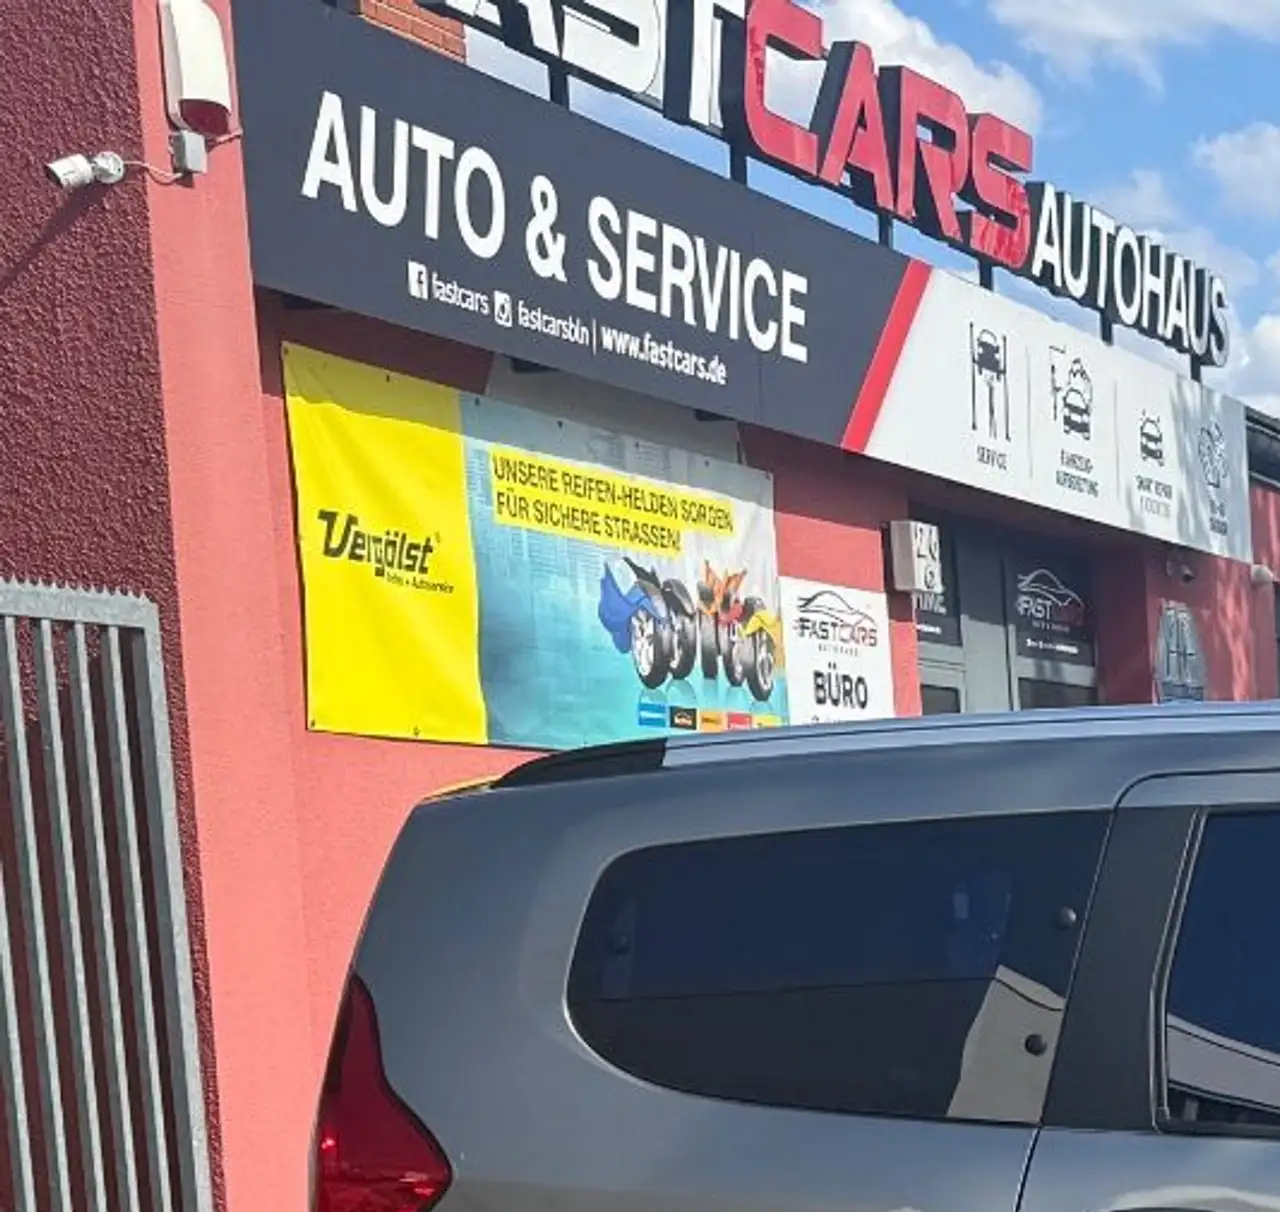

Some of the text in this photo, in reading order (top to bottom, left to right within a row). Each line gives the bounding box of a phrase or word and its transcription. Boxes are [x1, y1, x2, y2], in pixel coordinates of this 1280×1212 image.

[302, 91, 808, 363] AUTO & SERVICE
[432, 272, 490, 316] fastcars
[1032, 181, 1230, 367] AUTOHAUS
[601, 324, 727, 385] www.fastcars.de
[493, 454, 734, 533] UNSERE REIFEN-HELDEN SORGEN
[496, 487, 682, 551] FÜR SICHERE STRASSEN!
[317, 509, 434, 577] Vergölst
[796, 617, 878, 648] FASTCARS
[813, 661, 868, 710] BÜRO
